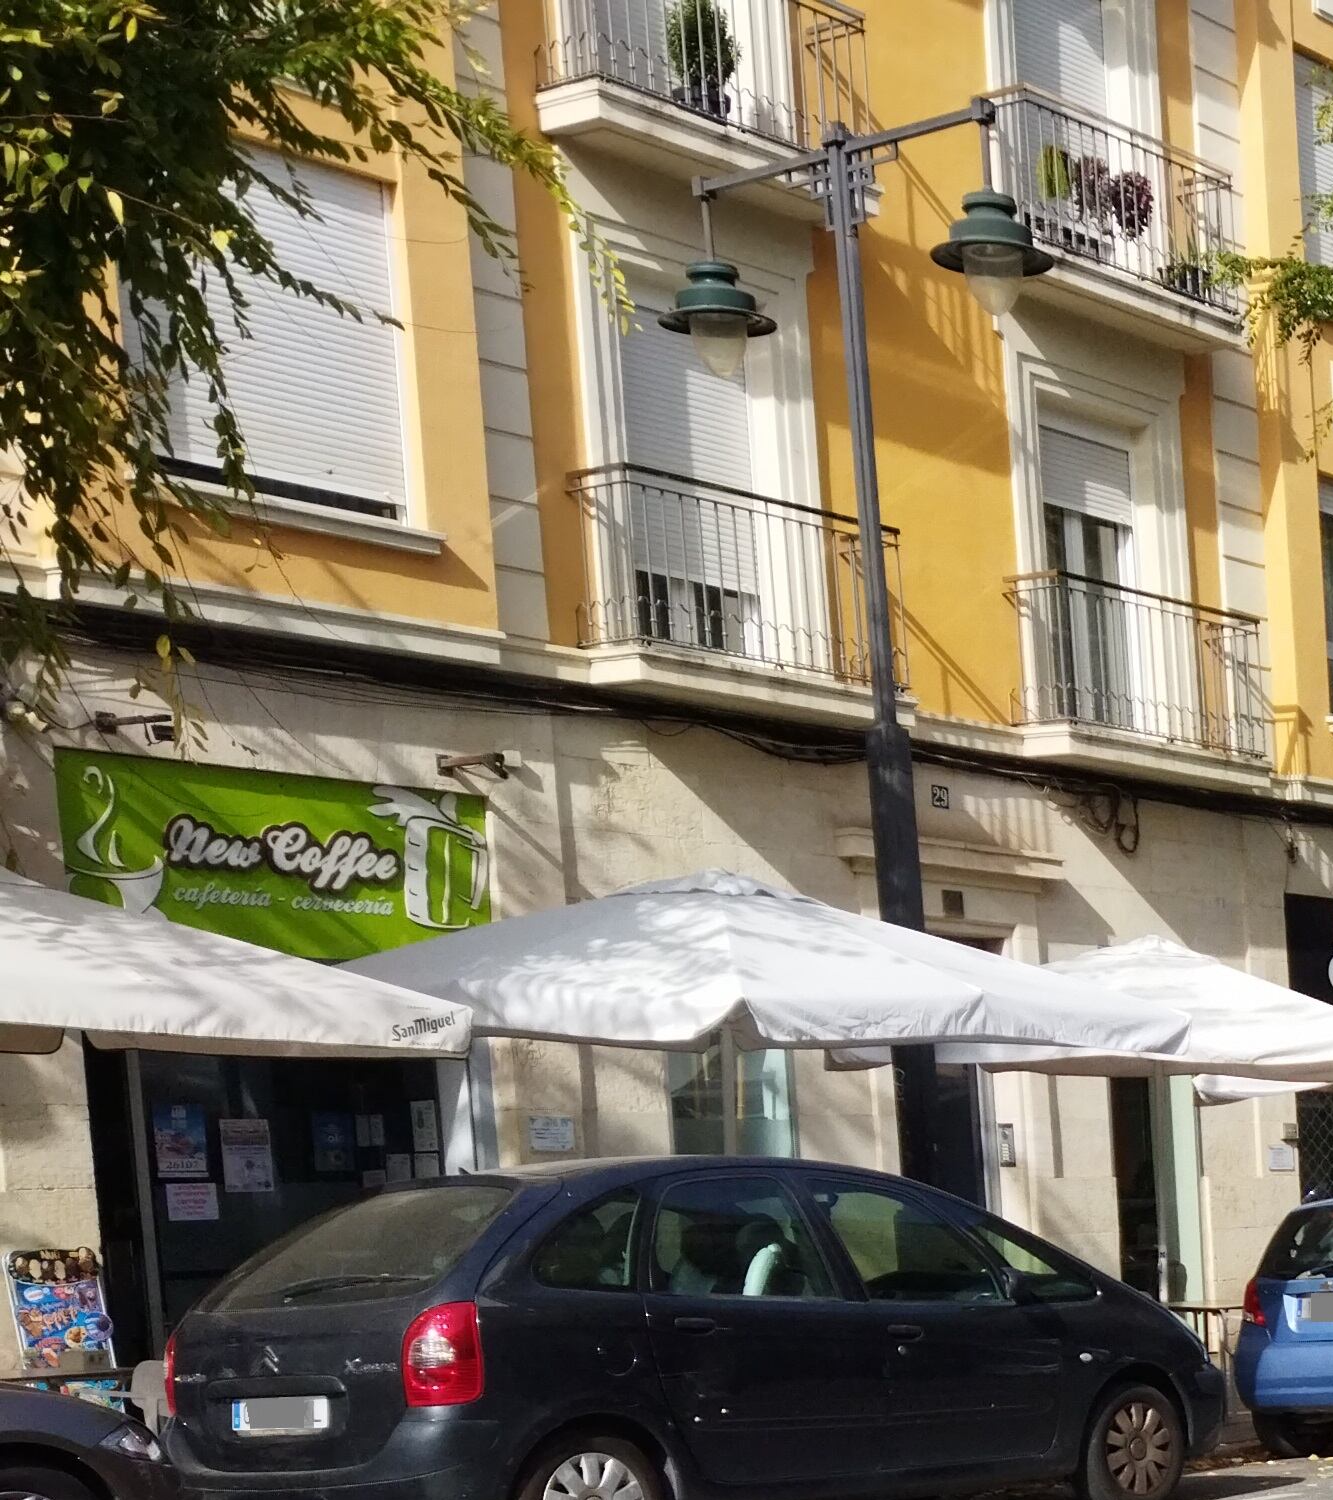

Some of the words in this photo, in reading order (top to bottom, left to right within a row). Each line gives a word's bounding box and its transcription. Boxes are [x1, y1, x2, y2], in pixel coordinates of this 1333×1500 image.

[932, 786, 947, 807] 29
[168, 817, 262, 869] New
[266, 826, 399, 891] Coffee
[173, 881, 272, 910] cafetería
[291, 894, 395, 916] cervecería
